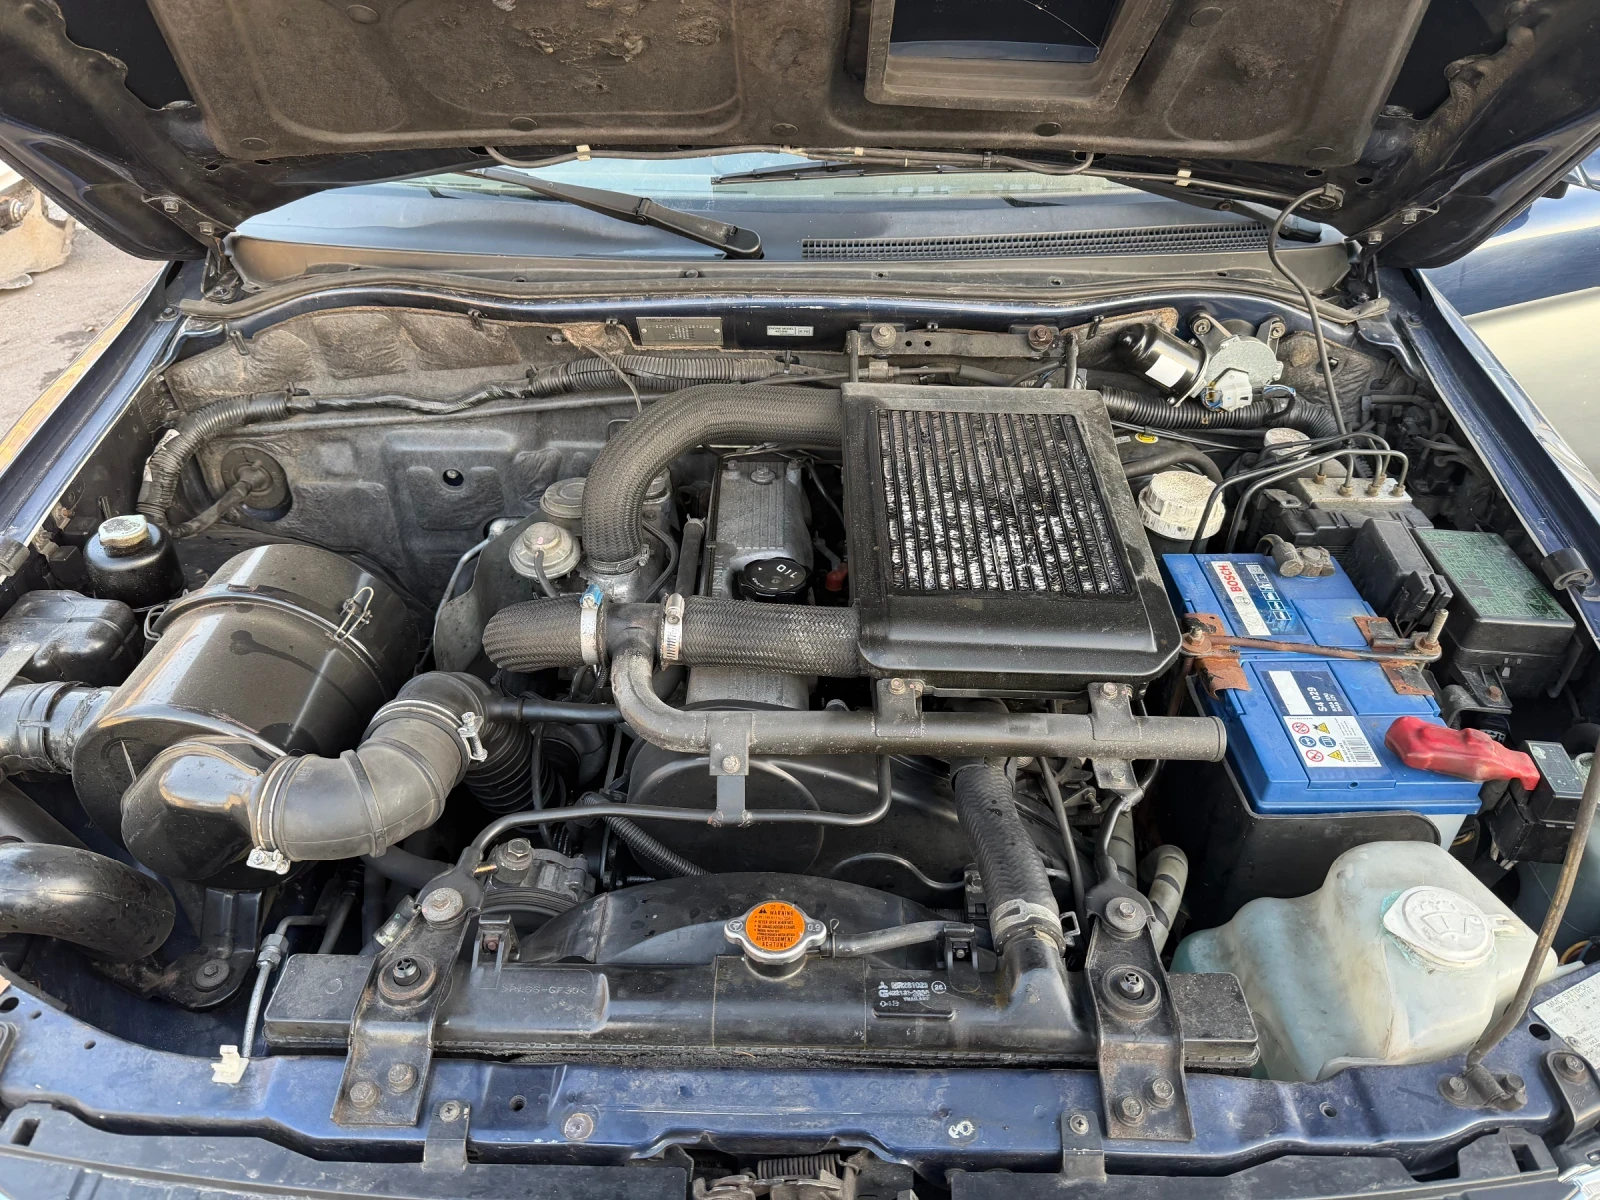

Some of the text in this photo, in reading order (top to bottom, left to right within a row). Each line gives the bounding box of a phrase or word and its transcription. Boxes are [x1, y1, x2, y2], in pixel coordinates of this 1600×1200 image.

[776, 564, 798, 579] OIL
[1217, 564, 1243, 593] BOSCH
[1307, 686, 1328, 712] S4 029
[807, 923, 821, 932] 0.9
